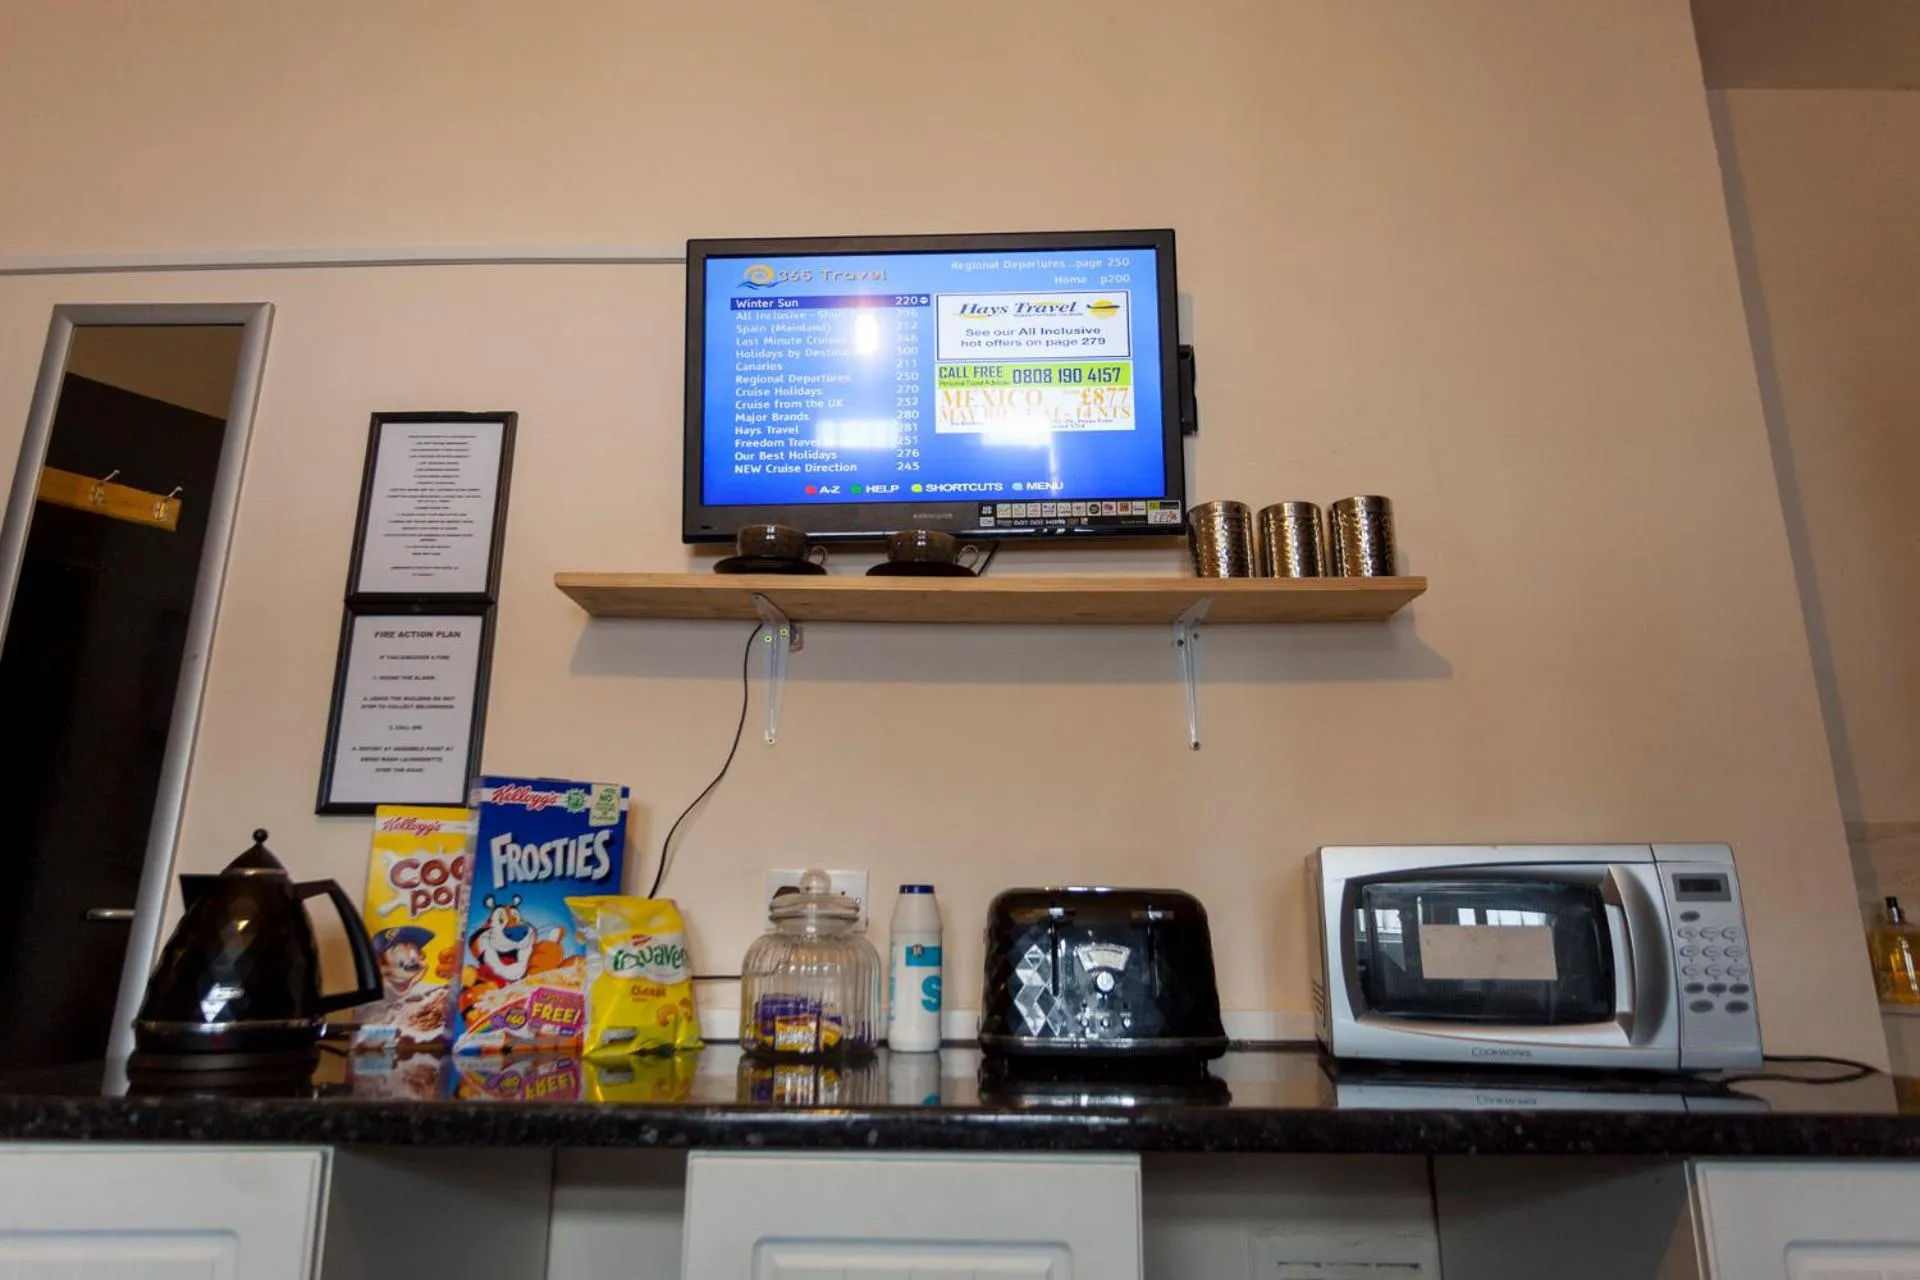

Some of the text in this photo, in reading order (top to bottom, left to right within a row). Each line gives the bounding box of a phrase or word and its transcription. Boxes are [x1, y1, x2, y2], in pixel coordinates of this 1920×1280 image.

[952, 259, 999, 272] Regional
[1107, 257, 1130, 267] 250
[779, 269, 887, 282] 365 Travel
[1054, 273, 1130, 286] Home p200
[736, 296, 918, 309] Winter Sun 220
[736, 310, 752, 321] All
[756, 309, 806, 320] Inclusive
[959, 303, 1010, 318] Hays
[1014, 301, 1078, 314] Travel
[736, 322, 767, 335] Spain
[771, 321, 832, 334] (Mainland)
[966, 325, 1101, 338] See our All Inclusive
[736, 336, 759, 347] Last
[764, 335, 802, 346] Minute
[961, 336, 1105, 349] hot offers on page 279
[736, 348, 784, 360] Holidays
[788, 348, 801, 360] by
[736, 362, 783, 373] Canaries
[736, 374, 784, 386] Regional
[788, 373, 850, 385] Departures
[939, 365, 1121, 384] CALL FREE 0808 190 4157
[736, 384, 919, 398] Cruise Holidays 270
[939, 388, 1045, 409] MEXICO
[1081, 386, 1129, 407] £877
[736, 399, 770, 409] Cruise
[775, 398, 802, 409] from
[805, 398, 824, 408] the
[828, 398, 844, 408] UK
[735, 410, 919, 424] Major Brands 280
[735, 425, 762, 437] Hays
[767, 424, 800, 435] Travel
[735, 438, 785, 449] Freedom
[789, 437, 820, 448] Travel
[735, 448, 920, 462] Our Best Holidays 276
[734, 461, 920, 475] NEW Cruise Direction 245
[819, 485, 841, 495] A-Z
[865, 484, 900, 494] HELP
[925, 482, 1004, 493] SHORTCUTS
[1026, 480, 1064, 492] MENU
[374, 630, 461, 639] FIRE ACTION PLAN
[490, 829, 611, 889] FROSTIES
[531, 1002, 582, 1025] FREE!
